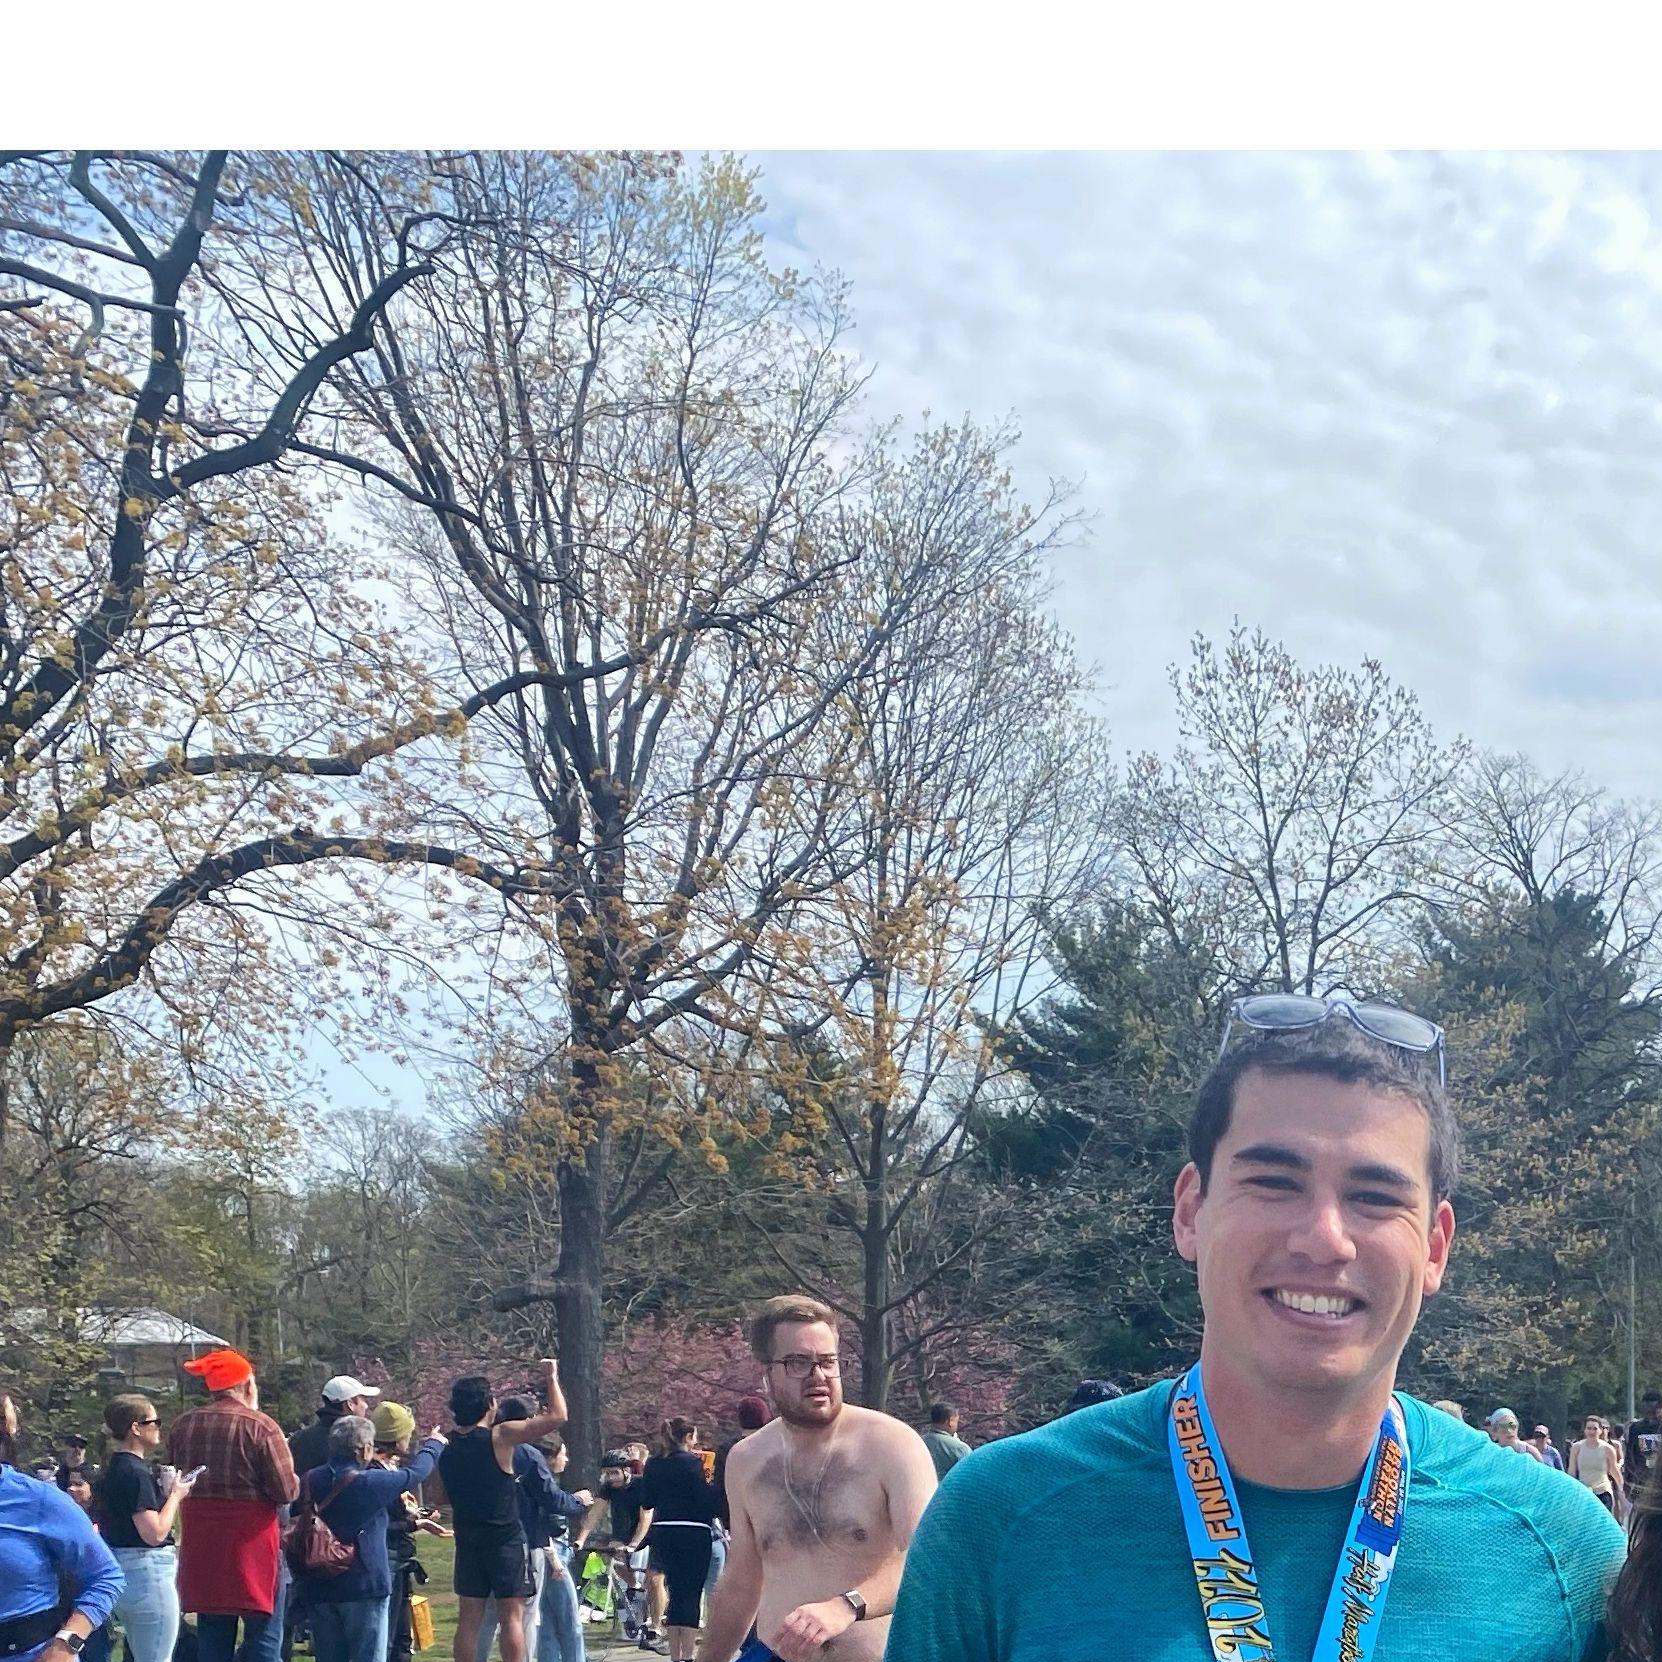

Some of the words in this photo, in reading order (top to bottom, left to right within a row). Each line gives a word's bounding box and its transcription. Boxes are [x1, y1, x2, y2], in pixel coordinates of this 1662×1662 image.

[1173, 1393, 1240, 1541] FINISHER
[1383, 1442, 1403, 1528] BROOKLYN
[1194, 1548, 1272, 1652] 2022
[1344, 1546, 1380, 1595] Half
